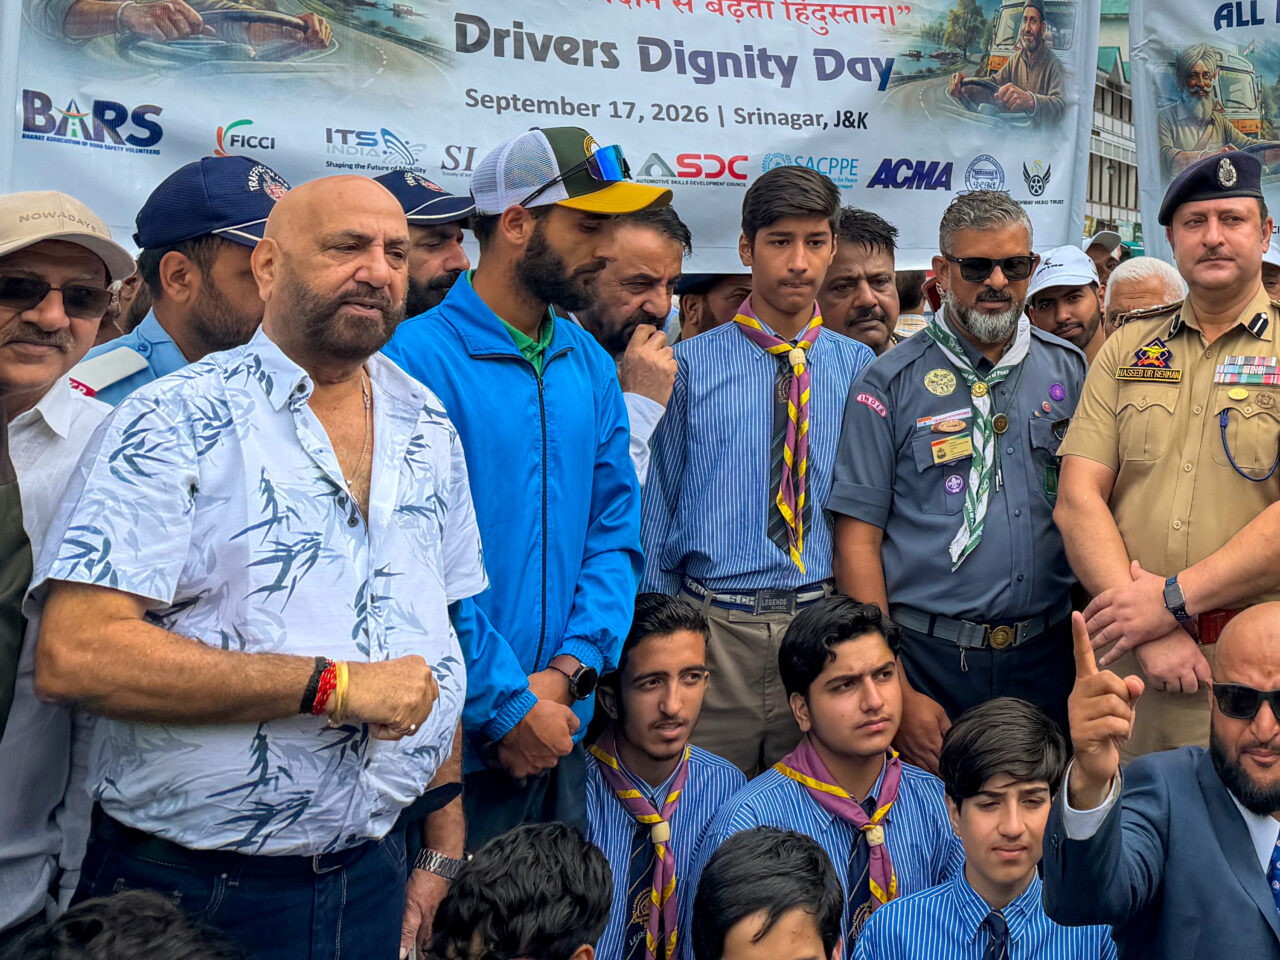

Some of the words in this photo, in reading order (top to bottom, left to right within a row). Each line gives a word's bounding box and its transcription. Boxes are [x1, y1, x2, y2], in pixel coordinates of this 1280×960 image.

[1213, 0, 1265, 32] ALL
[453, 12, 620, 69] Drivers
[637, 35, 798, 89] Dignity
[812, 47, 895, 92] Day
[22, 88, 163, 148] BARS
[465, 88, 600, 118] September
[608, 100, 645, 124] 17,
[651, 103, 709, 123] 2026
[734, 107, 829, 131] Srinagar,
[833, 109, 869, 130] J&K
[229, 134, 275, 150] FICCI
[325, 128, 378, 147] ITS
[326, 144, 381, 158] INDIA
[325, 160, 353, 172] Shaping
[354, 162, 366, 170] the
[367, 163, 390, 171] Future
[866, 158, 954, 191] ACMA
[18, 211, 97, 232] NOWADAYS
[860, 394, 884, 414] INDIA
